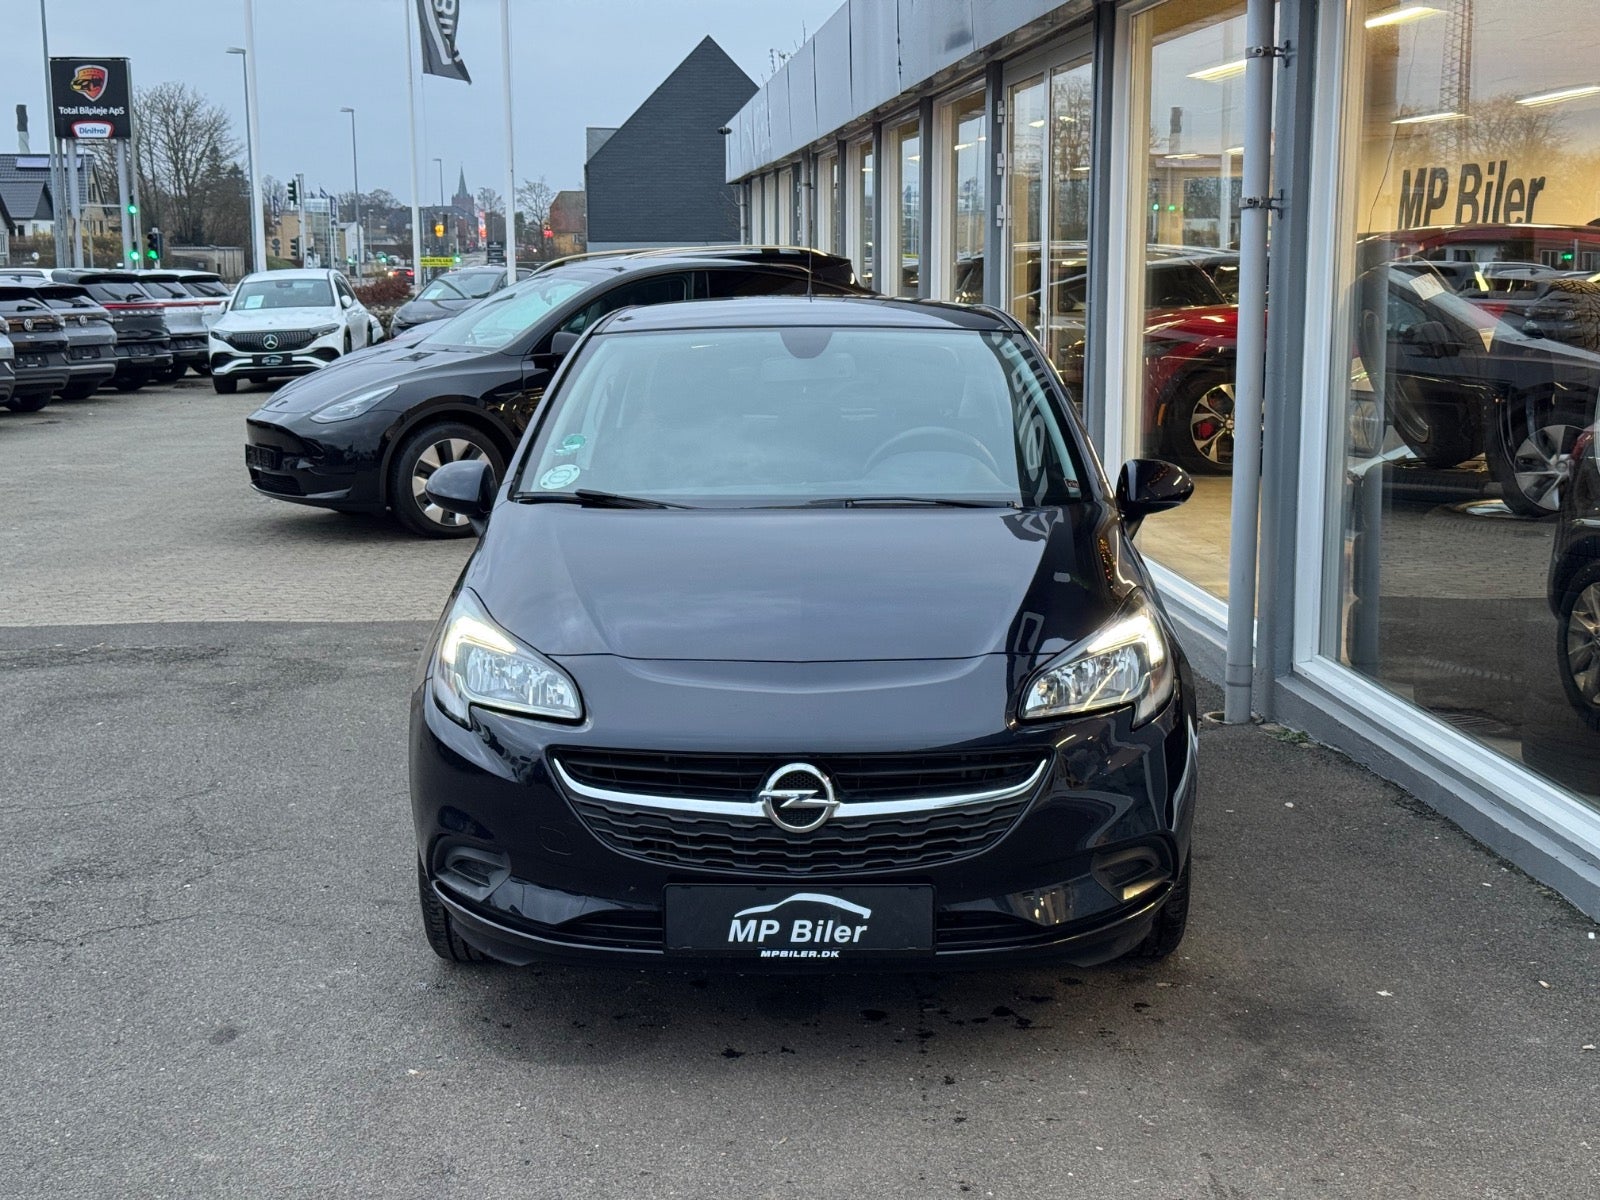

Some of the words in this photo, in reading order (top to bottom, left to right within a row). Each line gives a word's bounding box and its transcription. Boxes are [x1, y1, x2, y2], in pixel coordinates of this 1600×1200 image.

[58, 106, 79, 115] Total
[79, 106, 108, 116] Bilpleje
[108, 106, 125, 116] ApS
[79, 127, 107, 135] Dinitrol
[1397, 167, 1449, 230] MP
[1455, 160, 1546, 225] Biler
[727, 919, 780, 943] MP
[790, 919, 868, 943] Biler
[760, 950, 841, 958] MPBILER.DK
